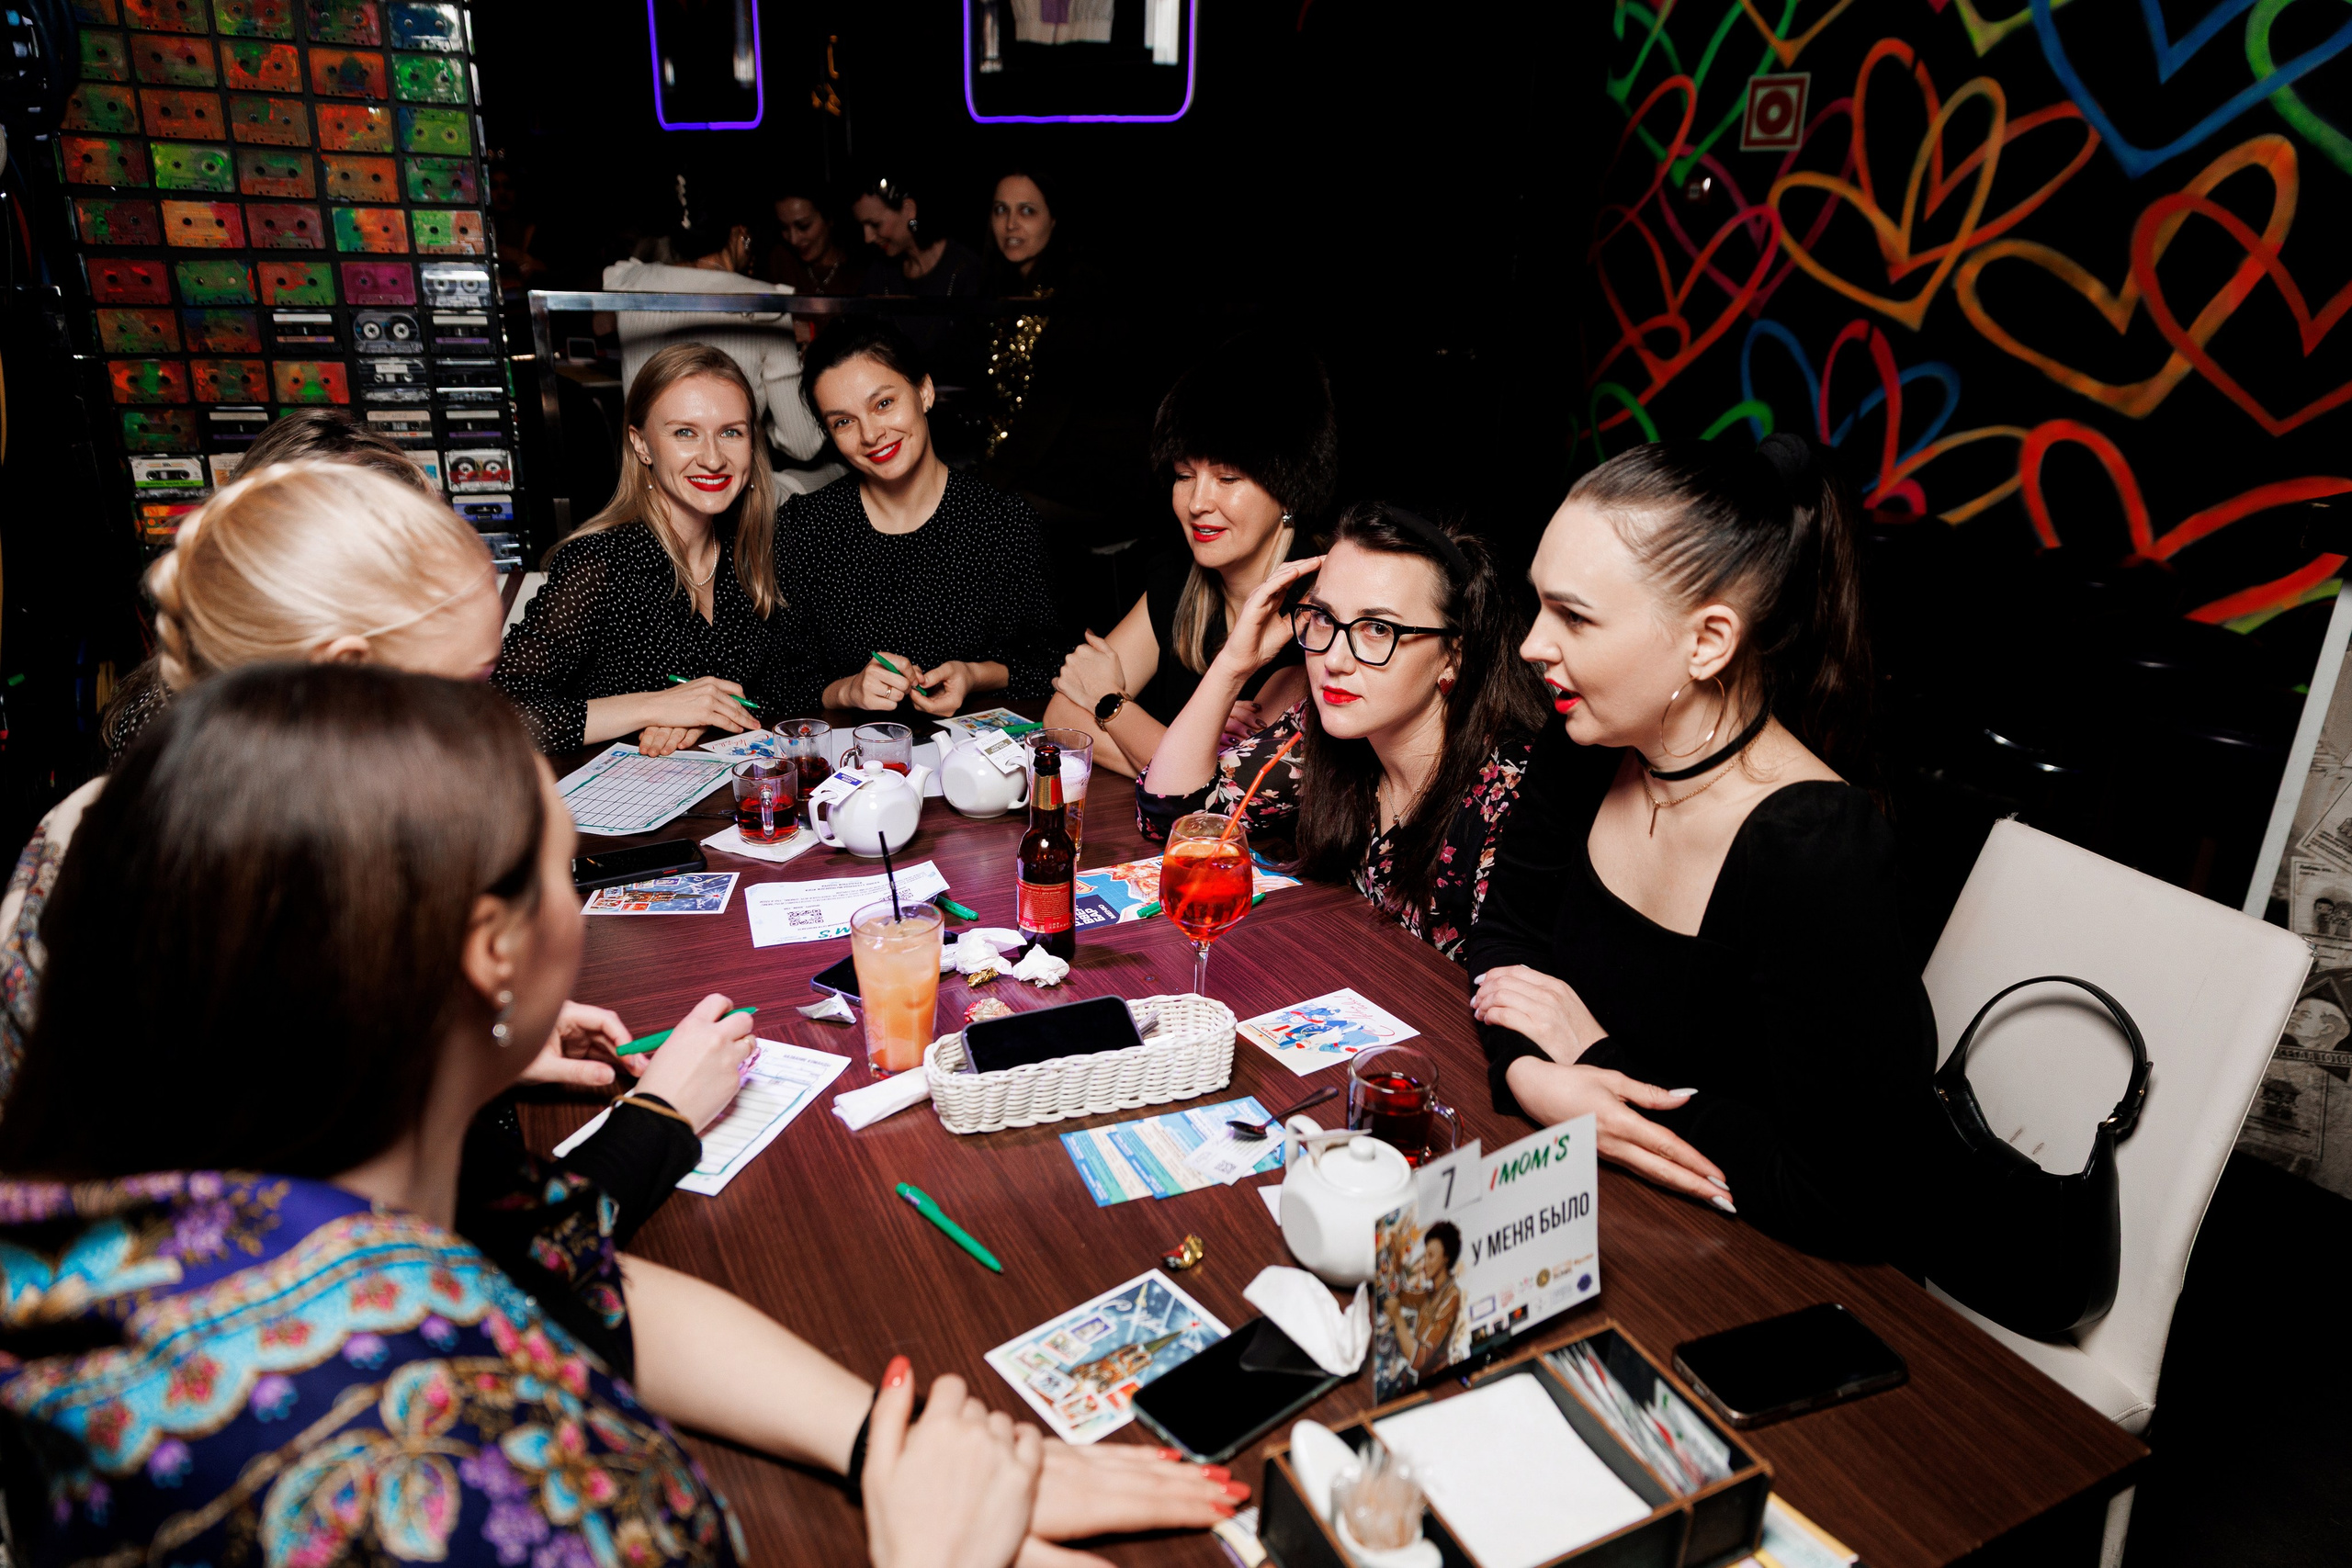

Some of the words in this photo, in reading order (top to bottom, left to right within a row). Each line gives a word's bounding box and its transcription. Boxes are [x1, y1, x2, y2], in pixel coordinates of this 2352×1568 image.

[1085, 908, 1105, 922] БАР
[1098, 905, 1116, 919] МЕНЮ
[1442, 1167, 1456, 1210] 7
[1471, 1240, 1483, 1267] У
[1487, 1214, 1535, 1260] МЕНЯ
[1539, 1191, 1590, 1235] БЫЛО
